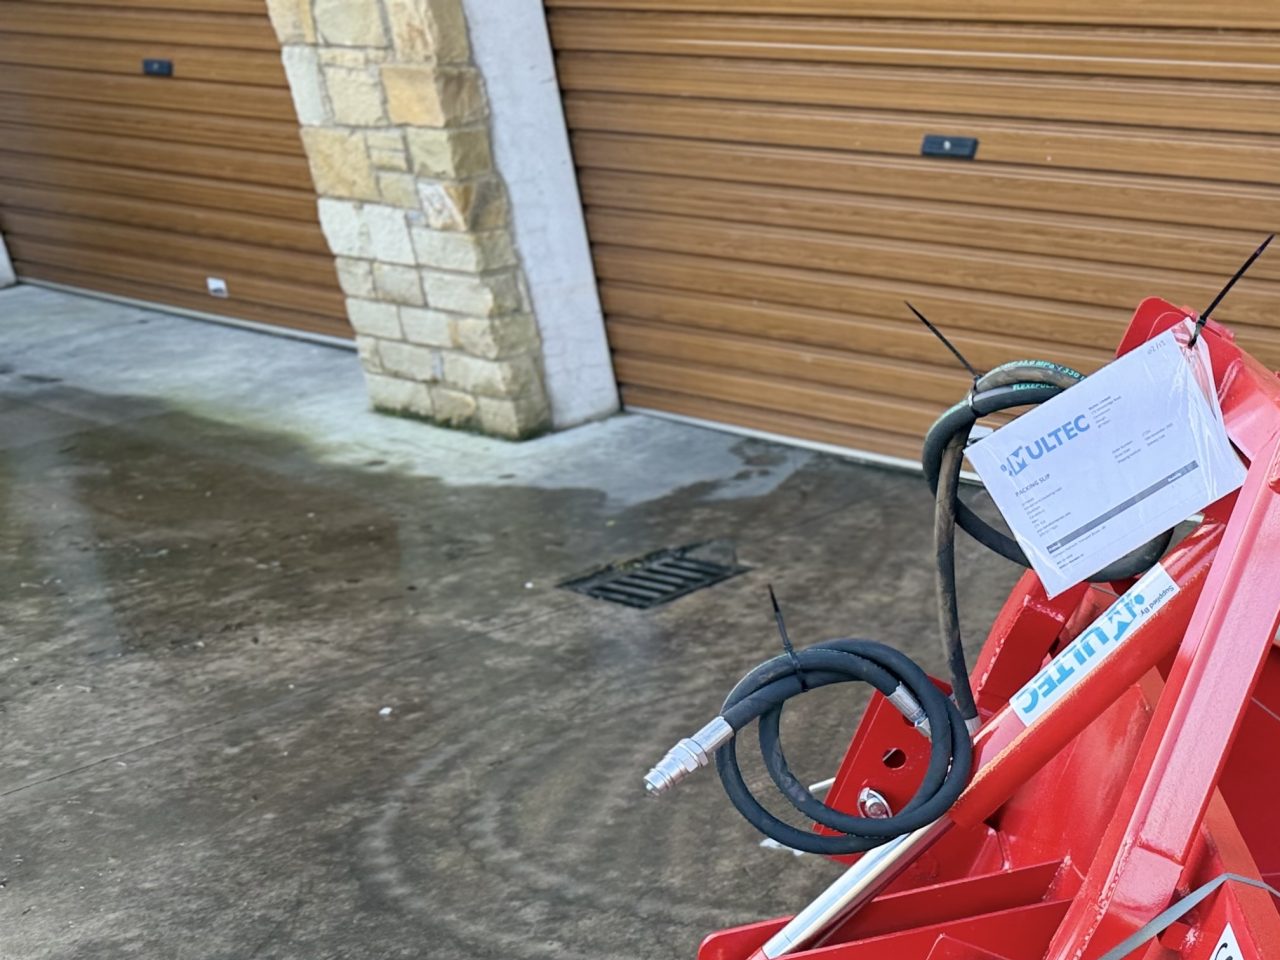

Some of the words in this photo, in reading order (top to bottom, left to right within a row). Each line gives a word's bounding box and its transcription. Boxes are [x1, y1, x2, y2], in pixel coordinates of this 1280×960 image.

[1005, 413, 1091, 476] MULTEC
[1015, 480, 1040, 497] PACKING
[1150, 585, 1175, 610] Supplied
[1139, 606, 1151, 618] By
[1015, 591, 1140, 715] MULTEC
